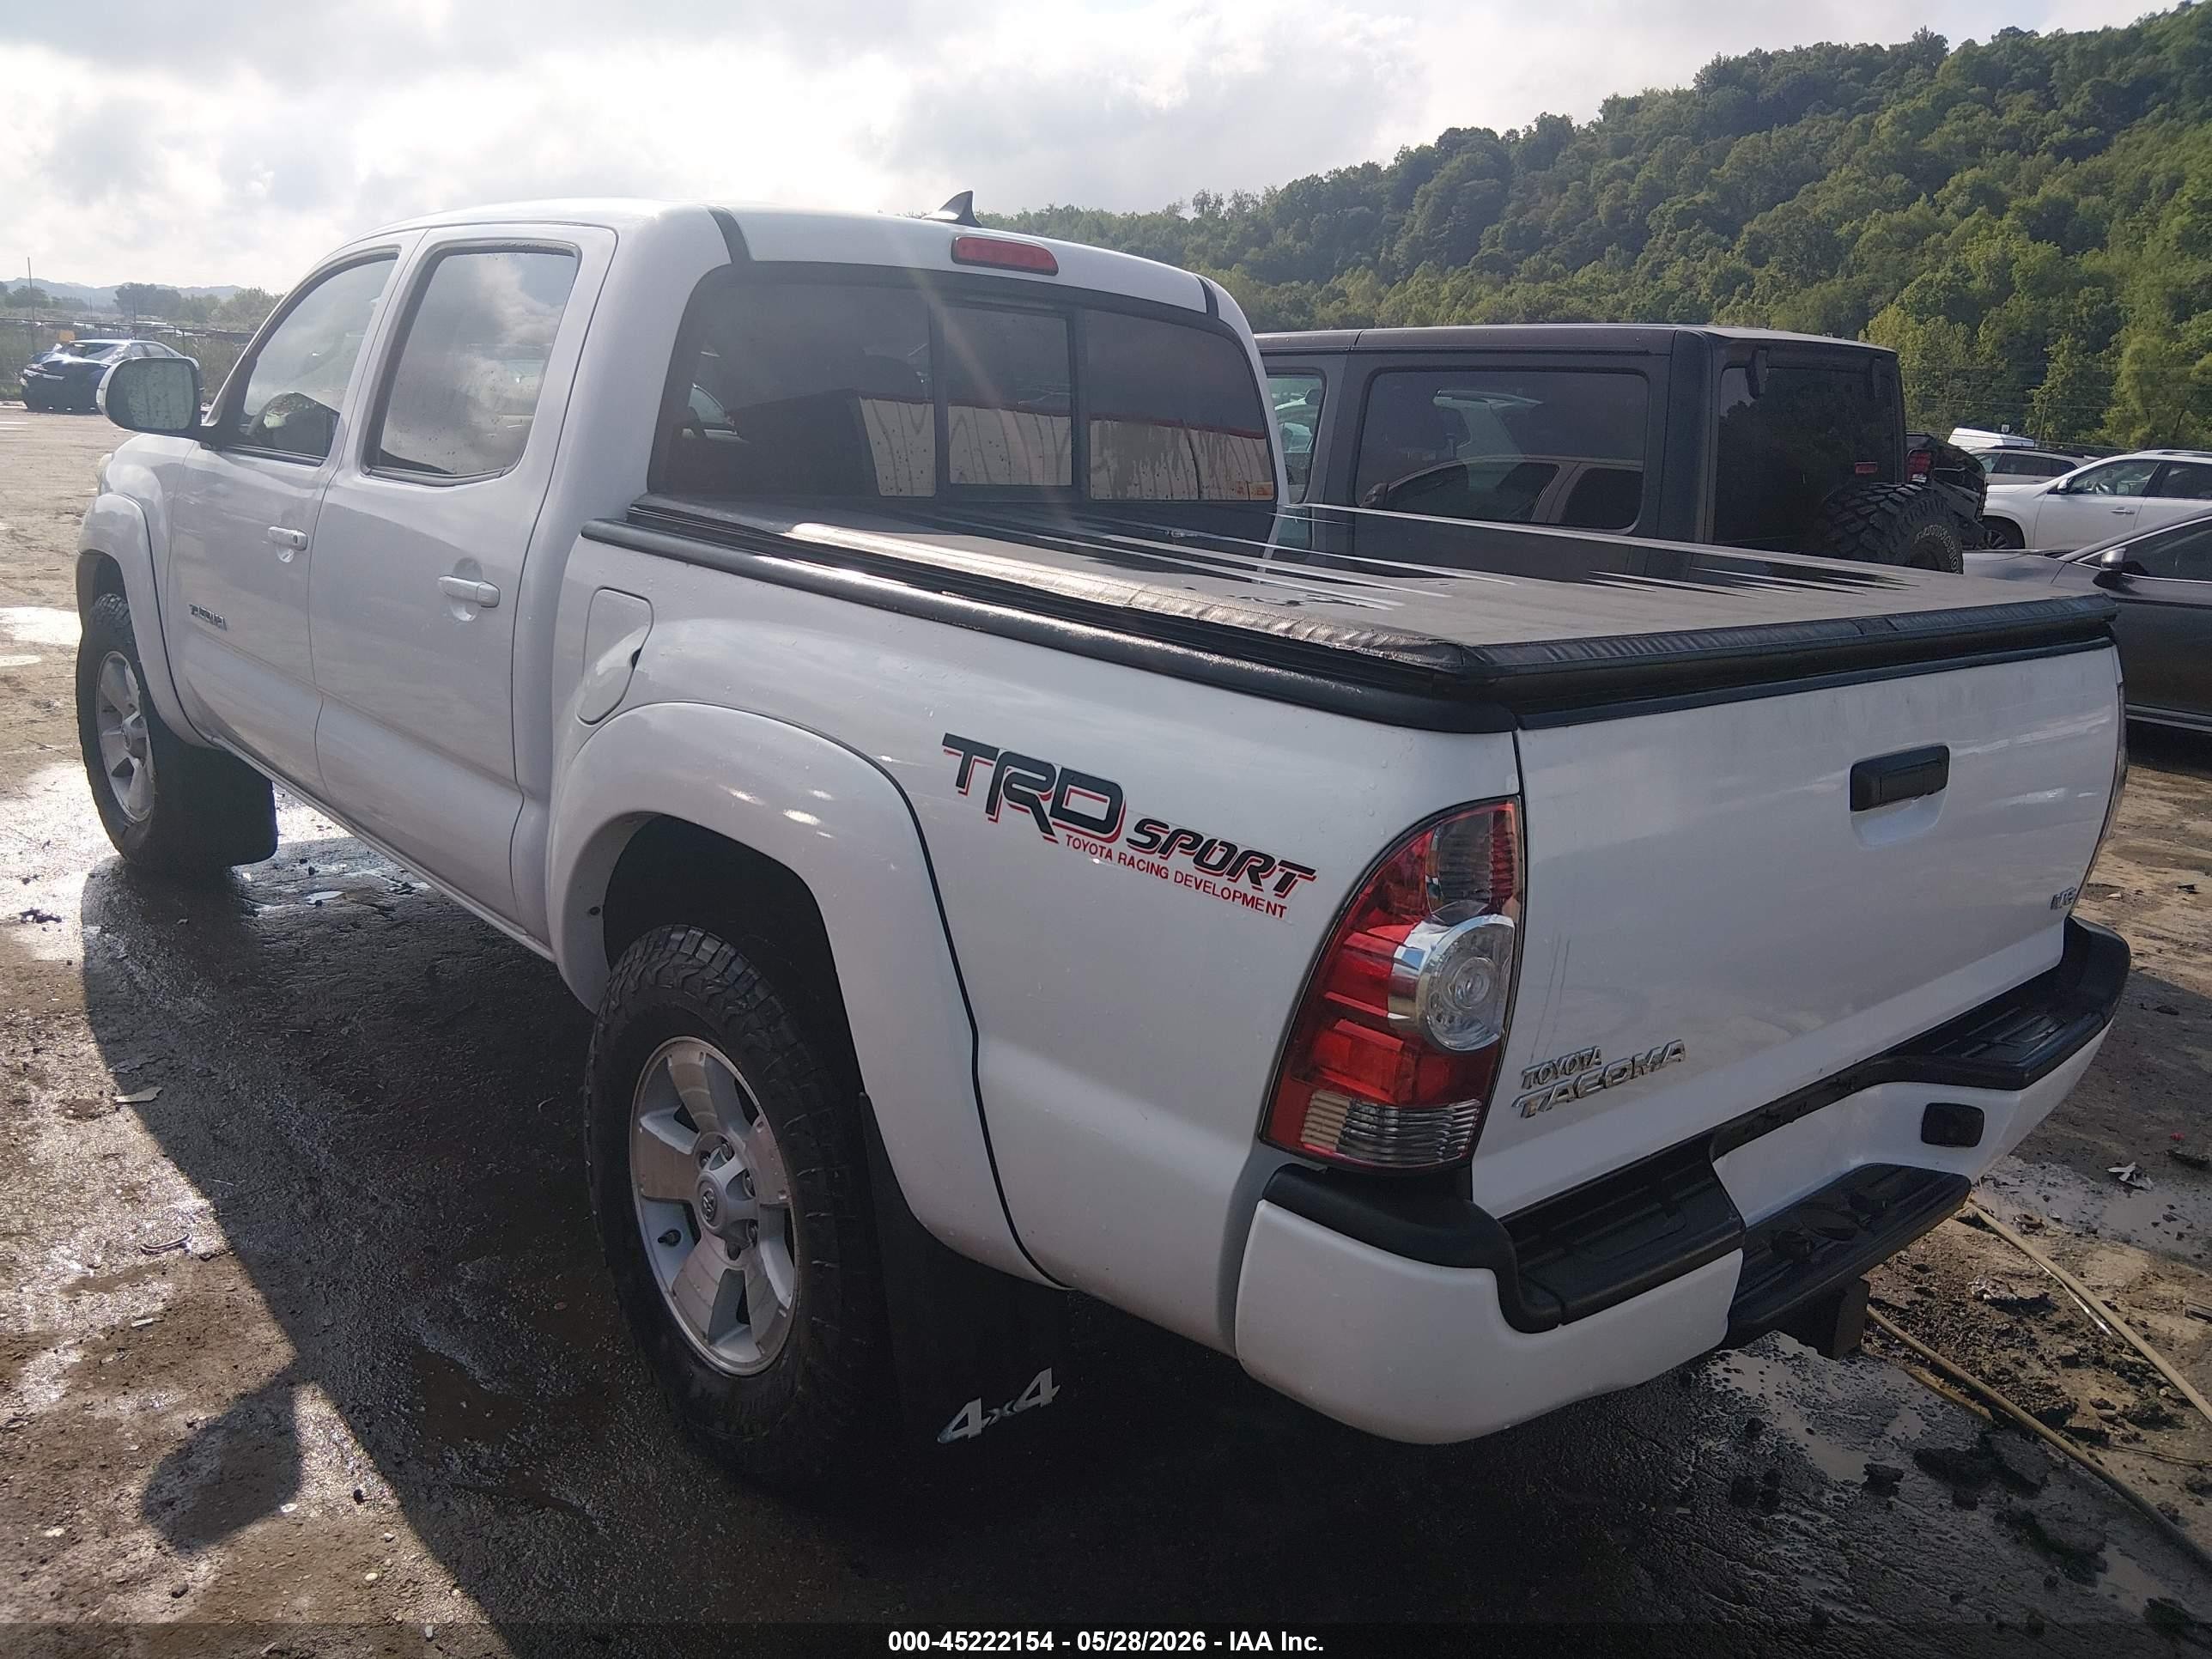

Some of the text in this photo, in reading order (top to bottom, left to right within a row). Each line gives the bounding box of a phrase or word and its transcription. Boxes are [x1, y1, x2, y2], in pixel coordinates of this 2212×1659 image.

[942, 732, 1318, 899] TRD SPORT
[1065, 833, 1288, 919] TOYOTA RACING DEVELOPMENT
[1511, 1038, 1686, 1119] TACOMA
[1521, 1044, 1602, 1090] TOYOTA
